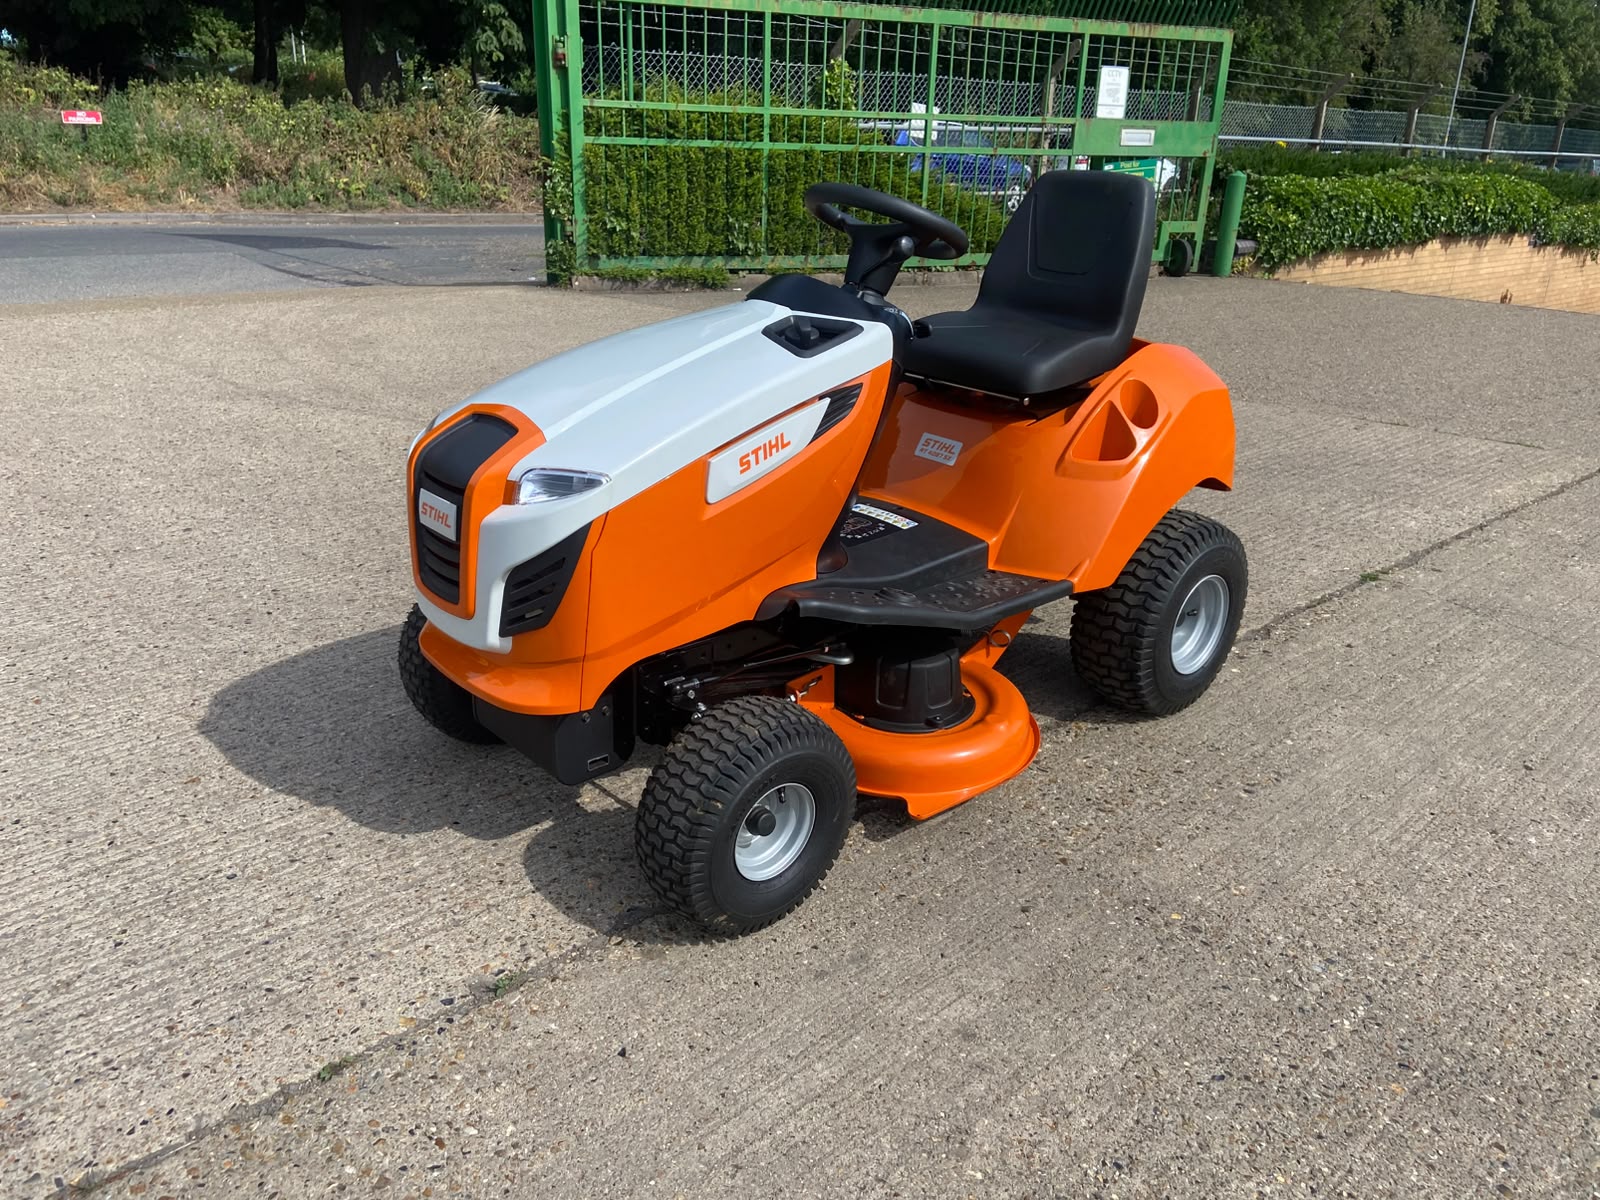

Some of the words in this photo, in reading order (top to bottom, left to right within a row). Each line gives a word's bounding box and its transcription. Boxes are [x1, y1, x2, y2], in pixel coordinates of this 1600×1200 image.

[739, 432, 791, 475] STIHL
[922, 438, 956, 454] STIHL
[421, 502, 451, 529] STIHL
